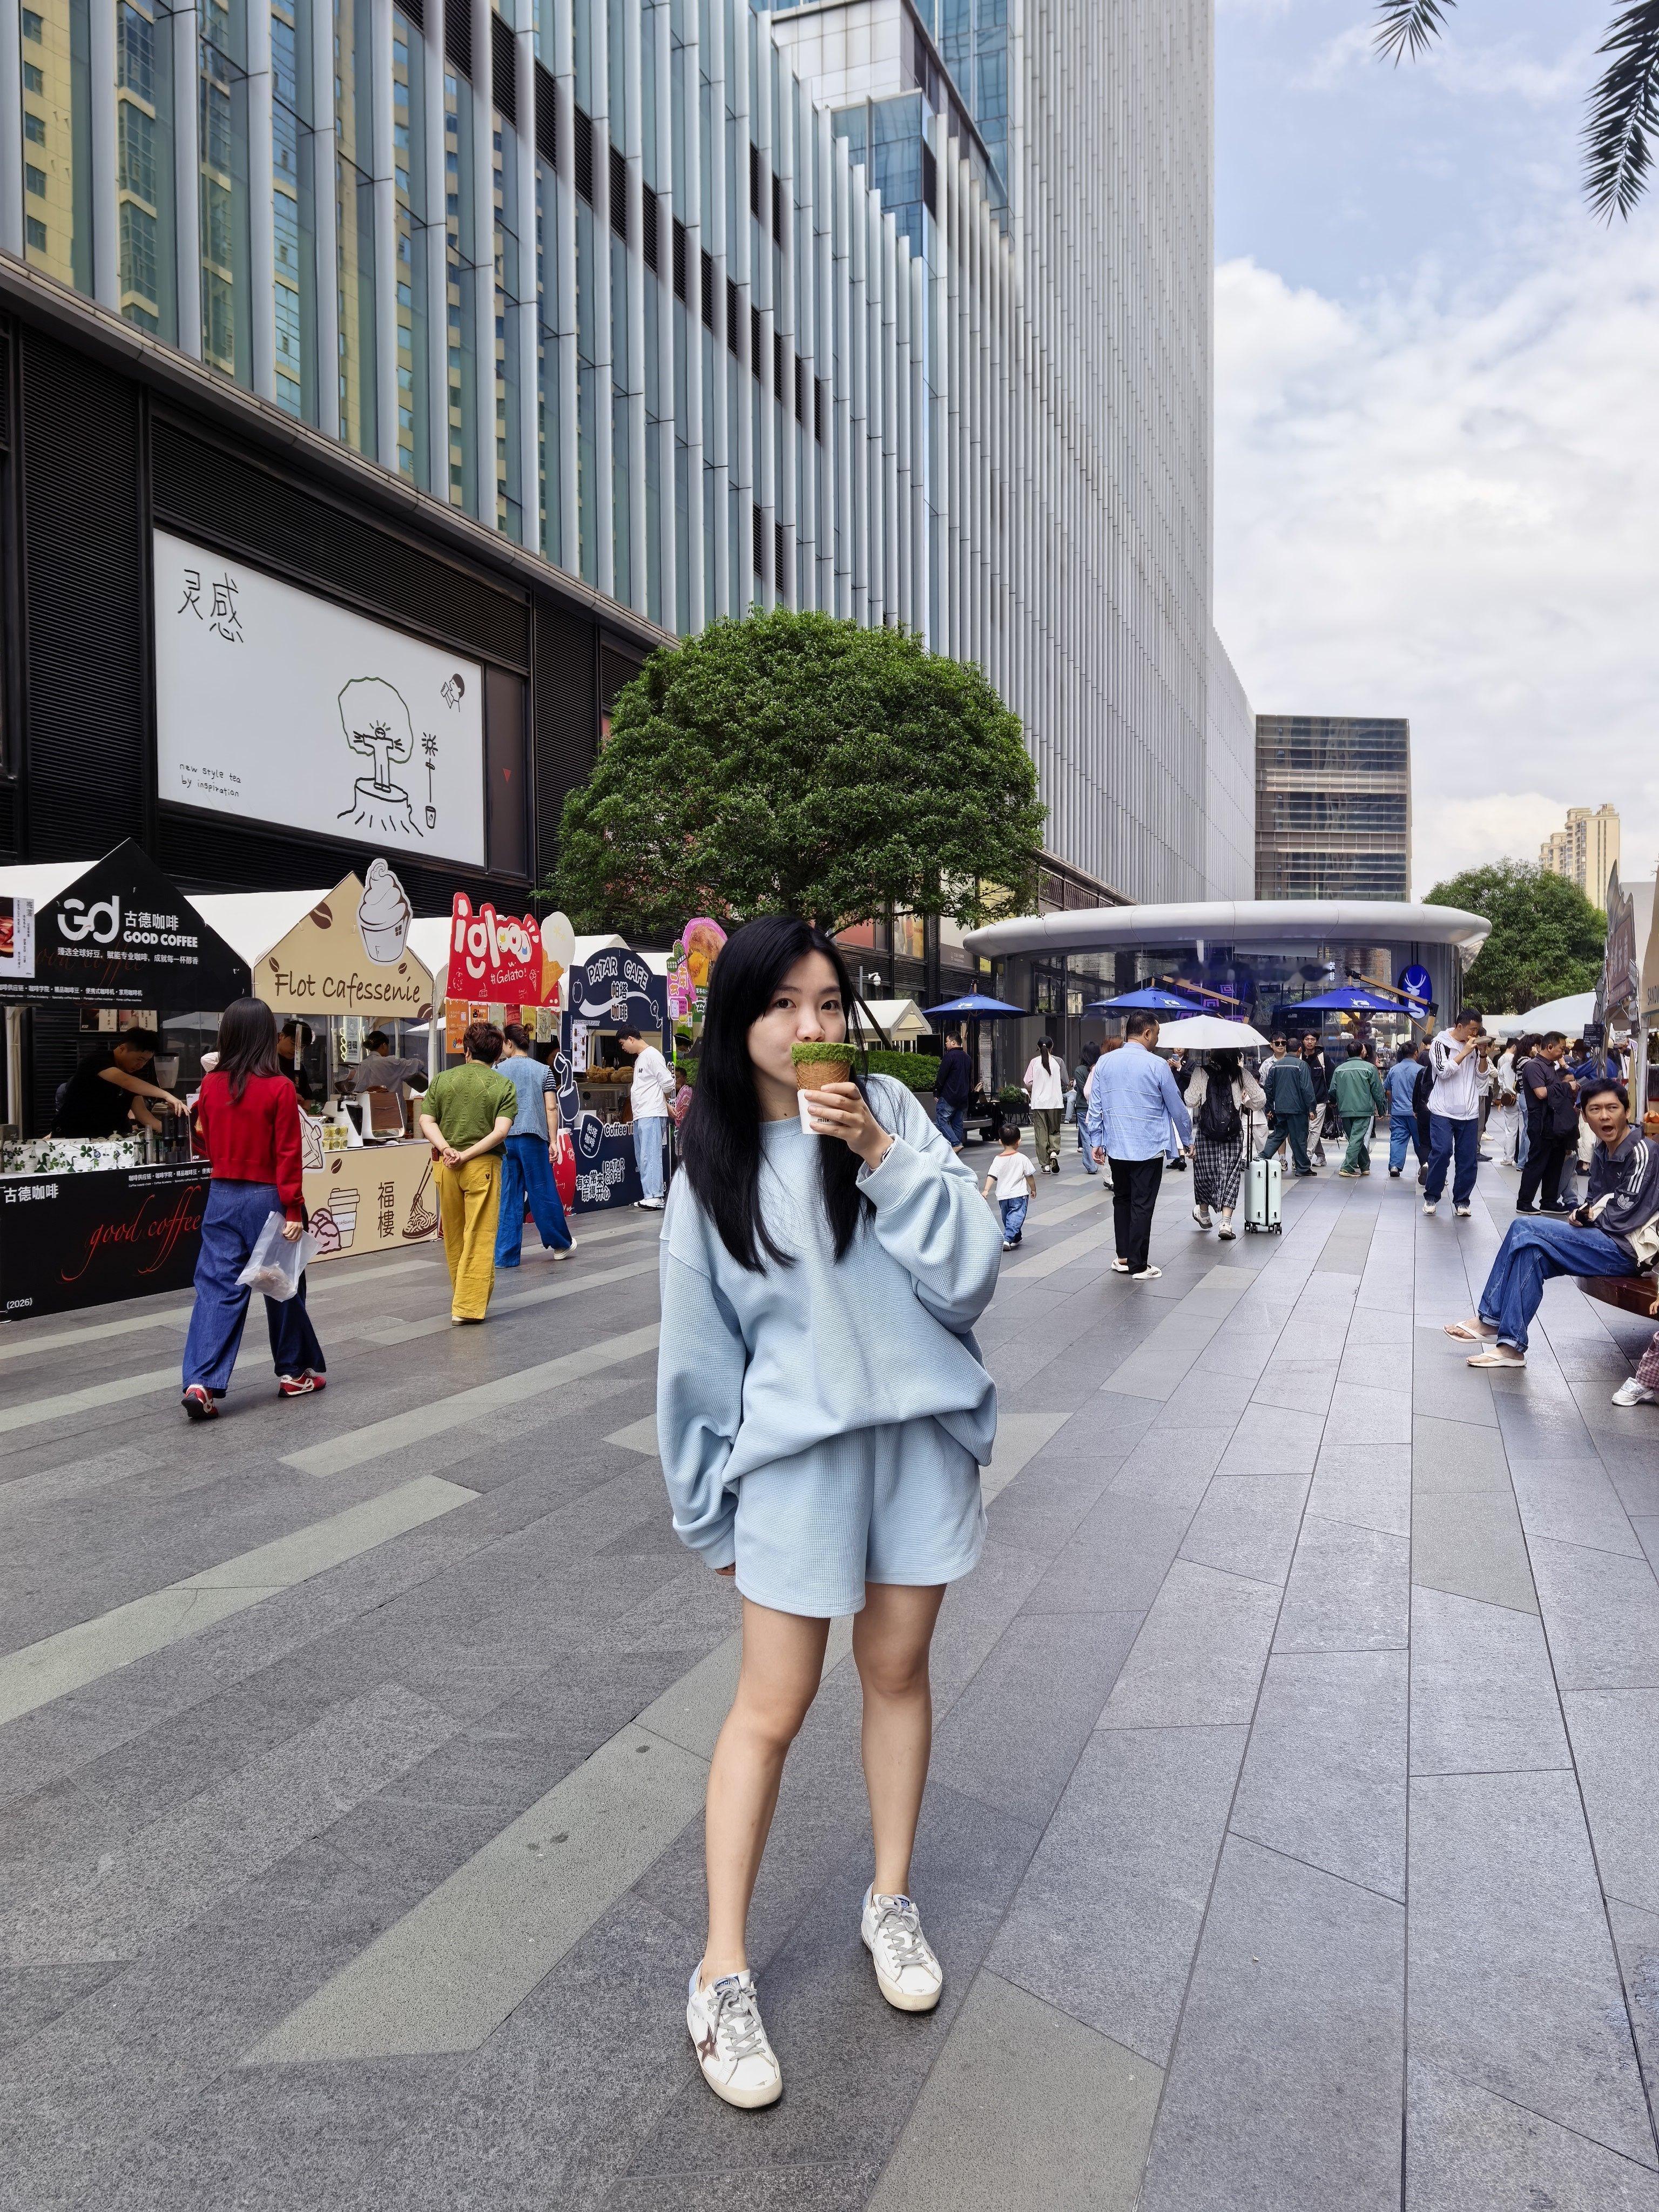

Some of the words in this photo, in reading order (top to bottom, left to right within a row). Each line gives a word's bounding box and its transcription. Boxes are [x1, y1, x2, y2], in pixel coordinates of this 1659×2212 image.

[178, 569, 244, 643] 灵感
[180, 764, 197, 773] new
[229, 772, 241, 783] tea
[181, 774, 192, 788] by
[197, 779, 239, 797] inspiration
[124, 911, 179, 931] 古德咖啡
[123, 930, 159, 945] GOOD
[160, 934, 198, 948] COFFEE
[587, 956, 618, 986] PATAR
[624, 959, 649, 991] CAFE
[275, 970, 316, 997] Flot
[322, 973, 420, 1008] Cafessenie
[611, 980, 629, 1000] 帕塔
[611, 1003, 628, 1022] 咖啡
[604, 1122, 627, 1137] Coffee
[576, 1170, 604, 1191] 有空常来
[3, 1183, 59, 1203] 古德咖啡
[582, 1185, 611, 1202] 玩得开心
[377, 1181, 395, 1239] 福樓
[60, 1194, 156, 1281] good
[138, 1185, 202, 1274] coffee
[6, 1297, 32, 1310] (2026)
